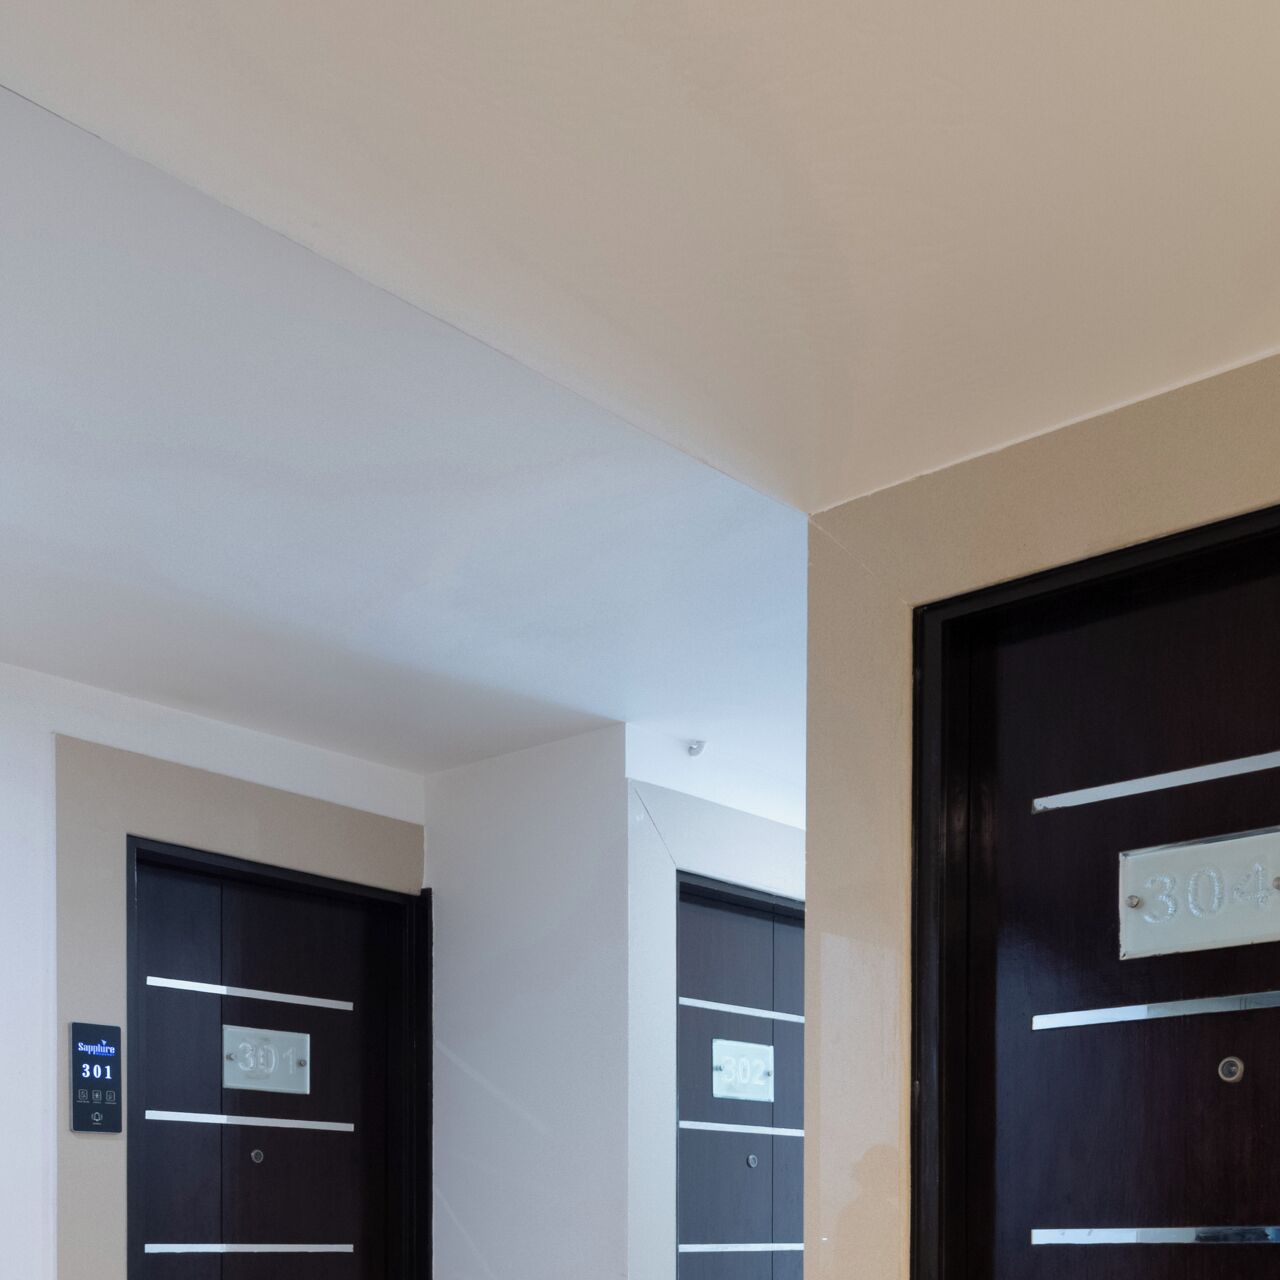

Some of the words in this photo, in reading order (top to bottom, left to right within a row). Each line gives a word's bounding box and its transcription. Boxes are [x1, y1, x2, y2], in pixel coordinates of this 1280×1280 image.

[1143, 862, 1270, 925] 304
[78, 1042, 115, 1055] Sapphire
[238, 1041, 296, 1075] 301
[81, 1063, 112, 1080] 301
